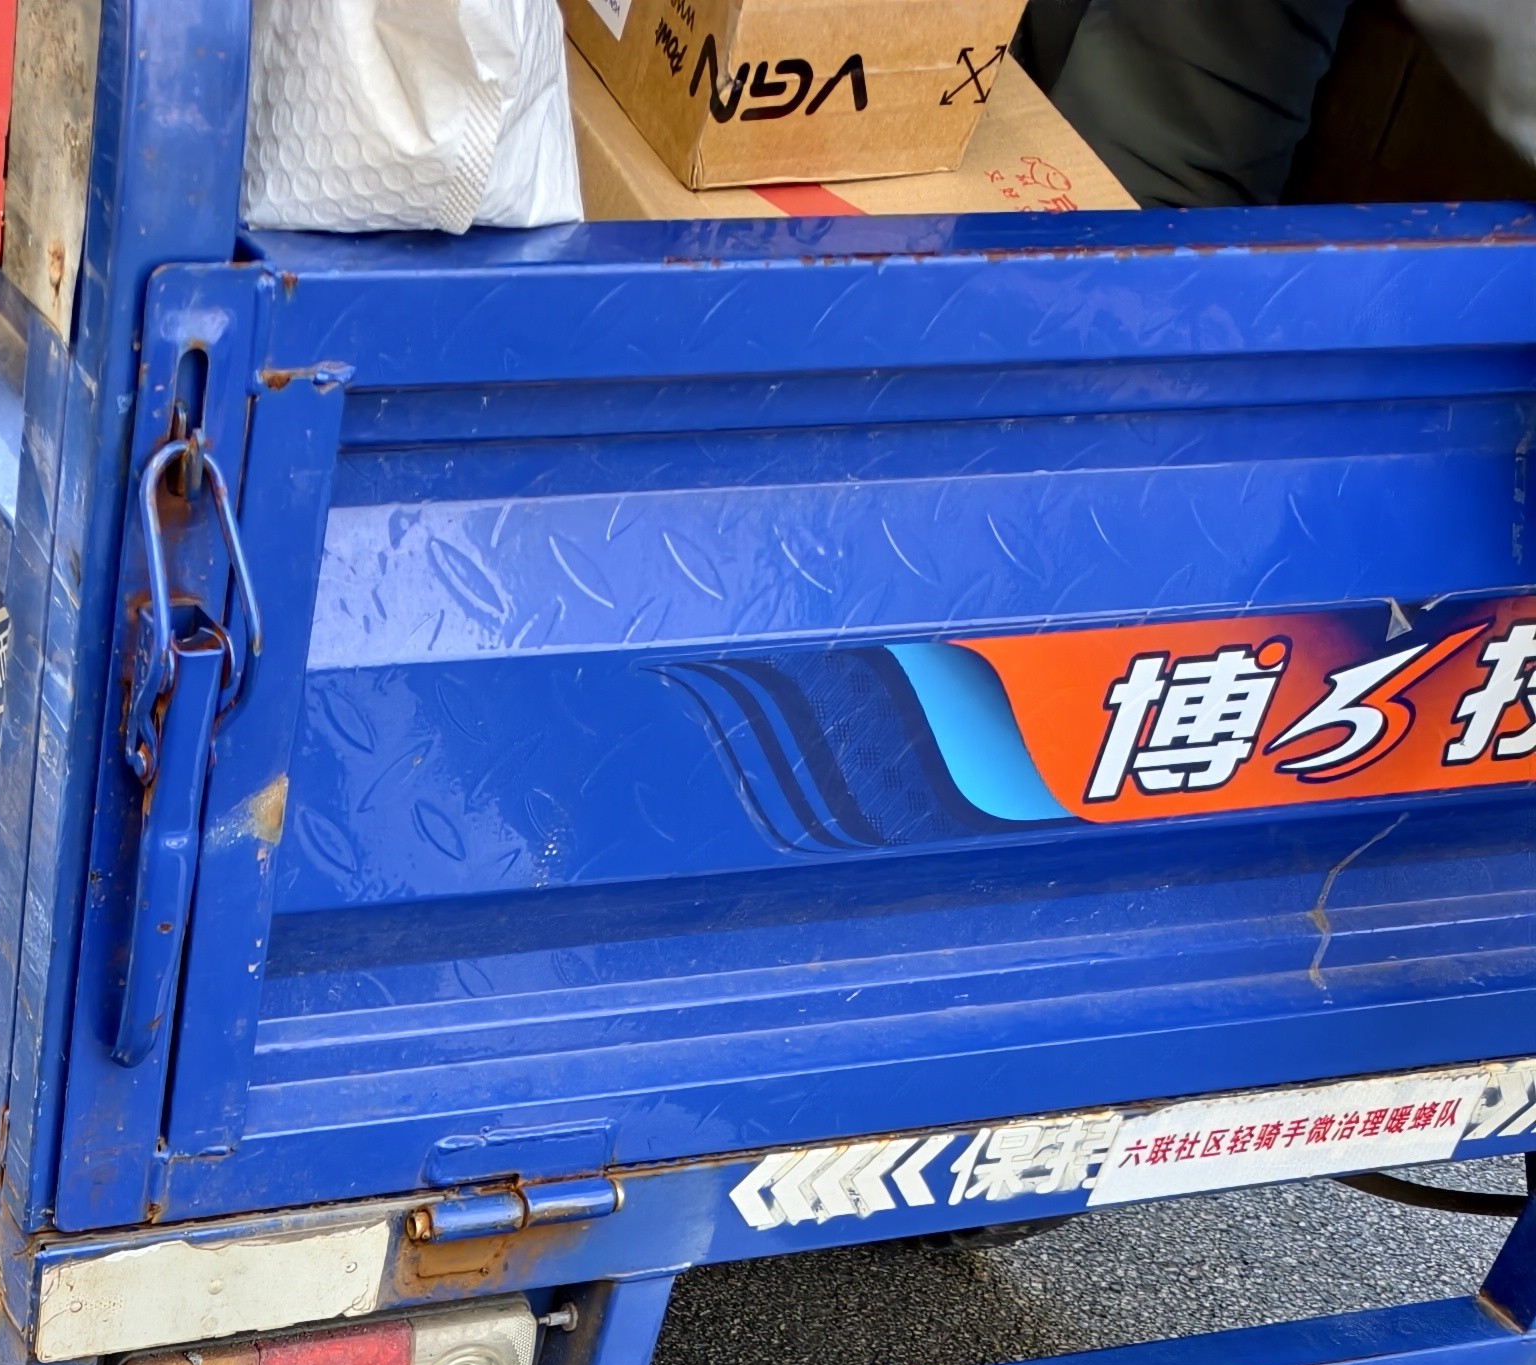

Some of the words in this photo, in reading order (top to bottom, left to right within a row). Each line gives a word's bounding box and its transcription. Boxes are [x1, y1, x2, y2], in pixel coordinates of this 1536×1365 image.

[689, 34, 868, 123] VGN
[1117, 1097, 1463, 1169] 六联社区轻骑手微治理暖蜂队
